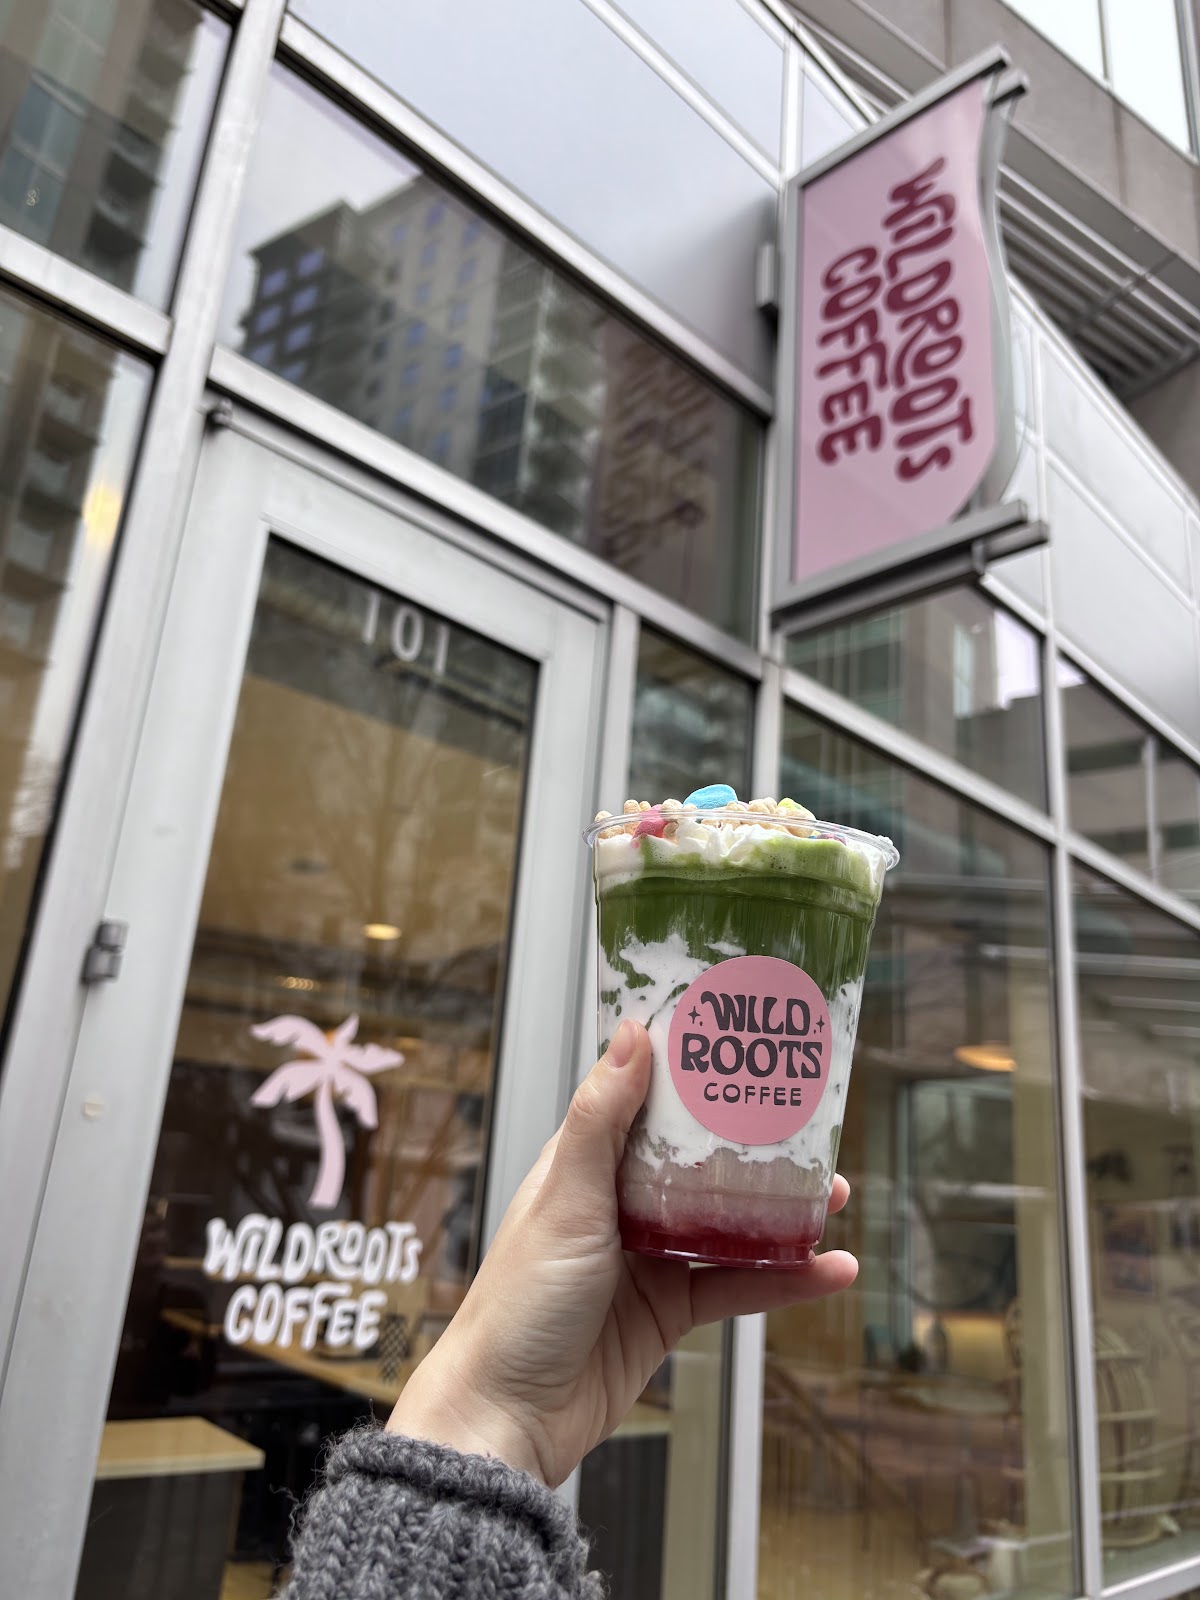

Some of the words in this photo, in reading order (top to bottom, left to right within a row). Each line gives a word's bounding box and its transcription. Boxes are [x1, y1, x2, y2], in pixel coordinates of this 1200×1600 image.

[817, 246, 888, 464] COFFEE
[361, 590, 450, 678] 101
[700, 990, 811, 1035] WILD
[680, 1032, 823, 1079] ROOTS
[703, 1082, 802, 1107] COFFEE
[225, 1282, 387, 1348] COFFEE
